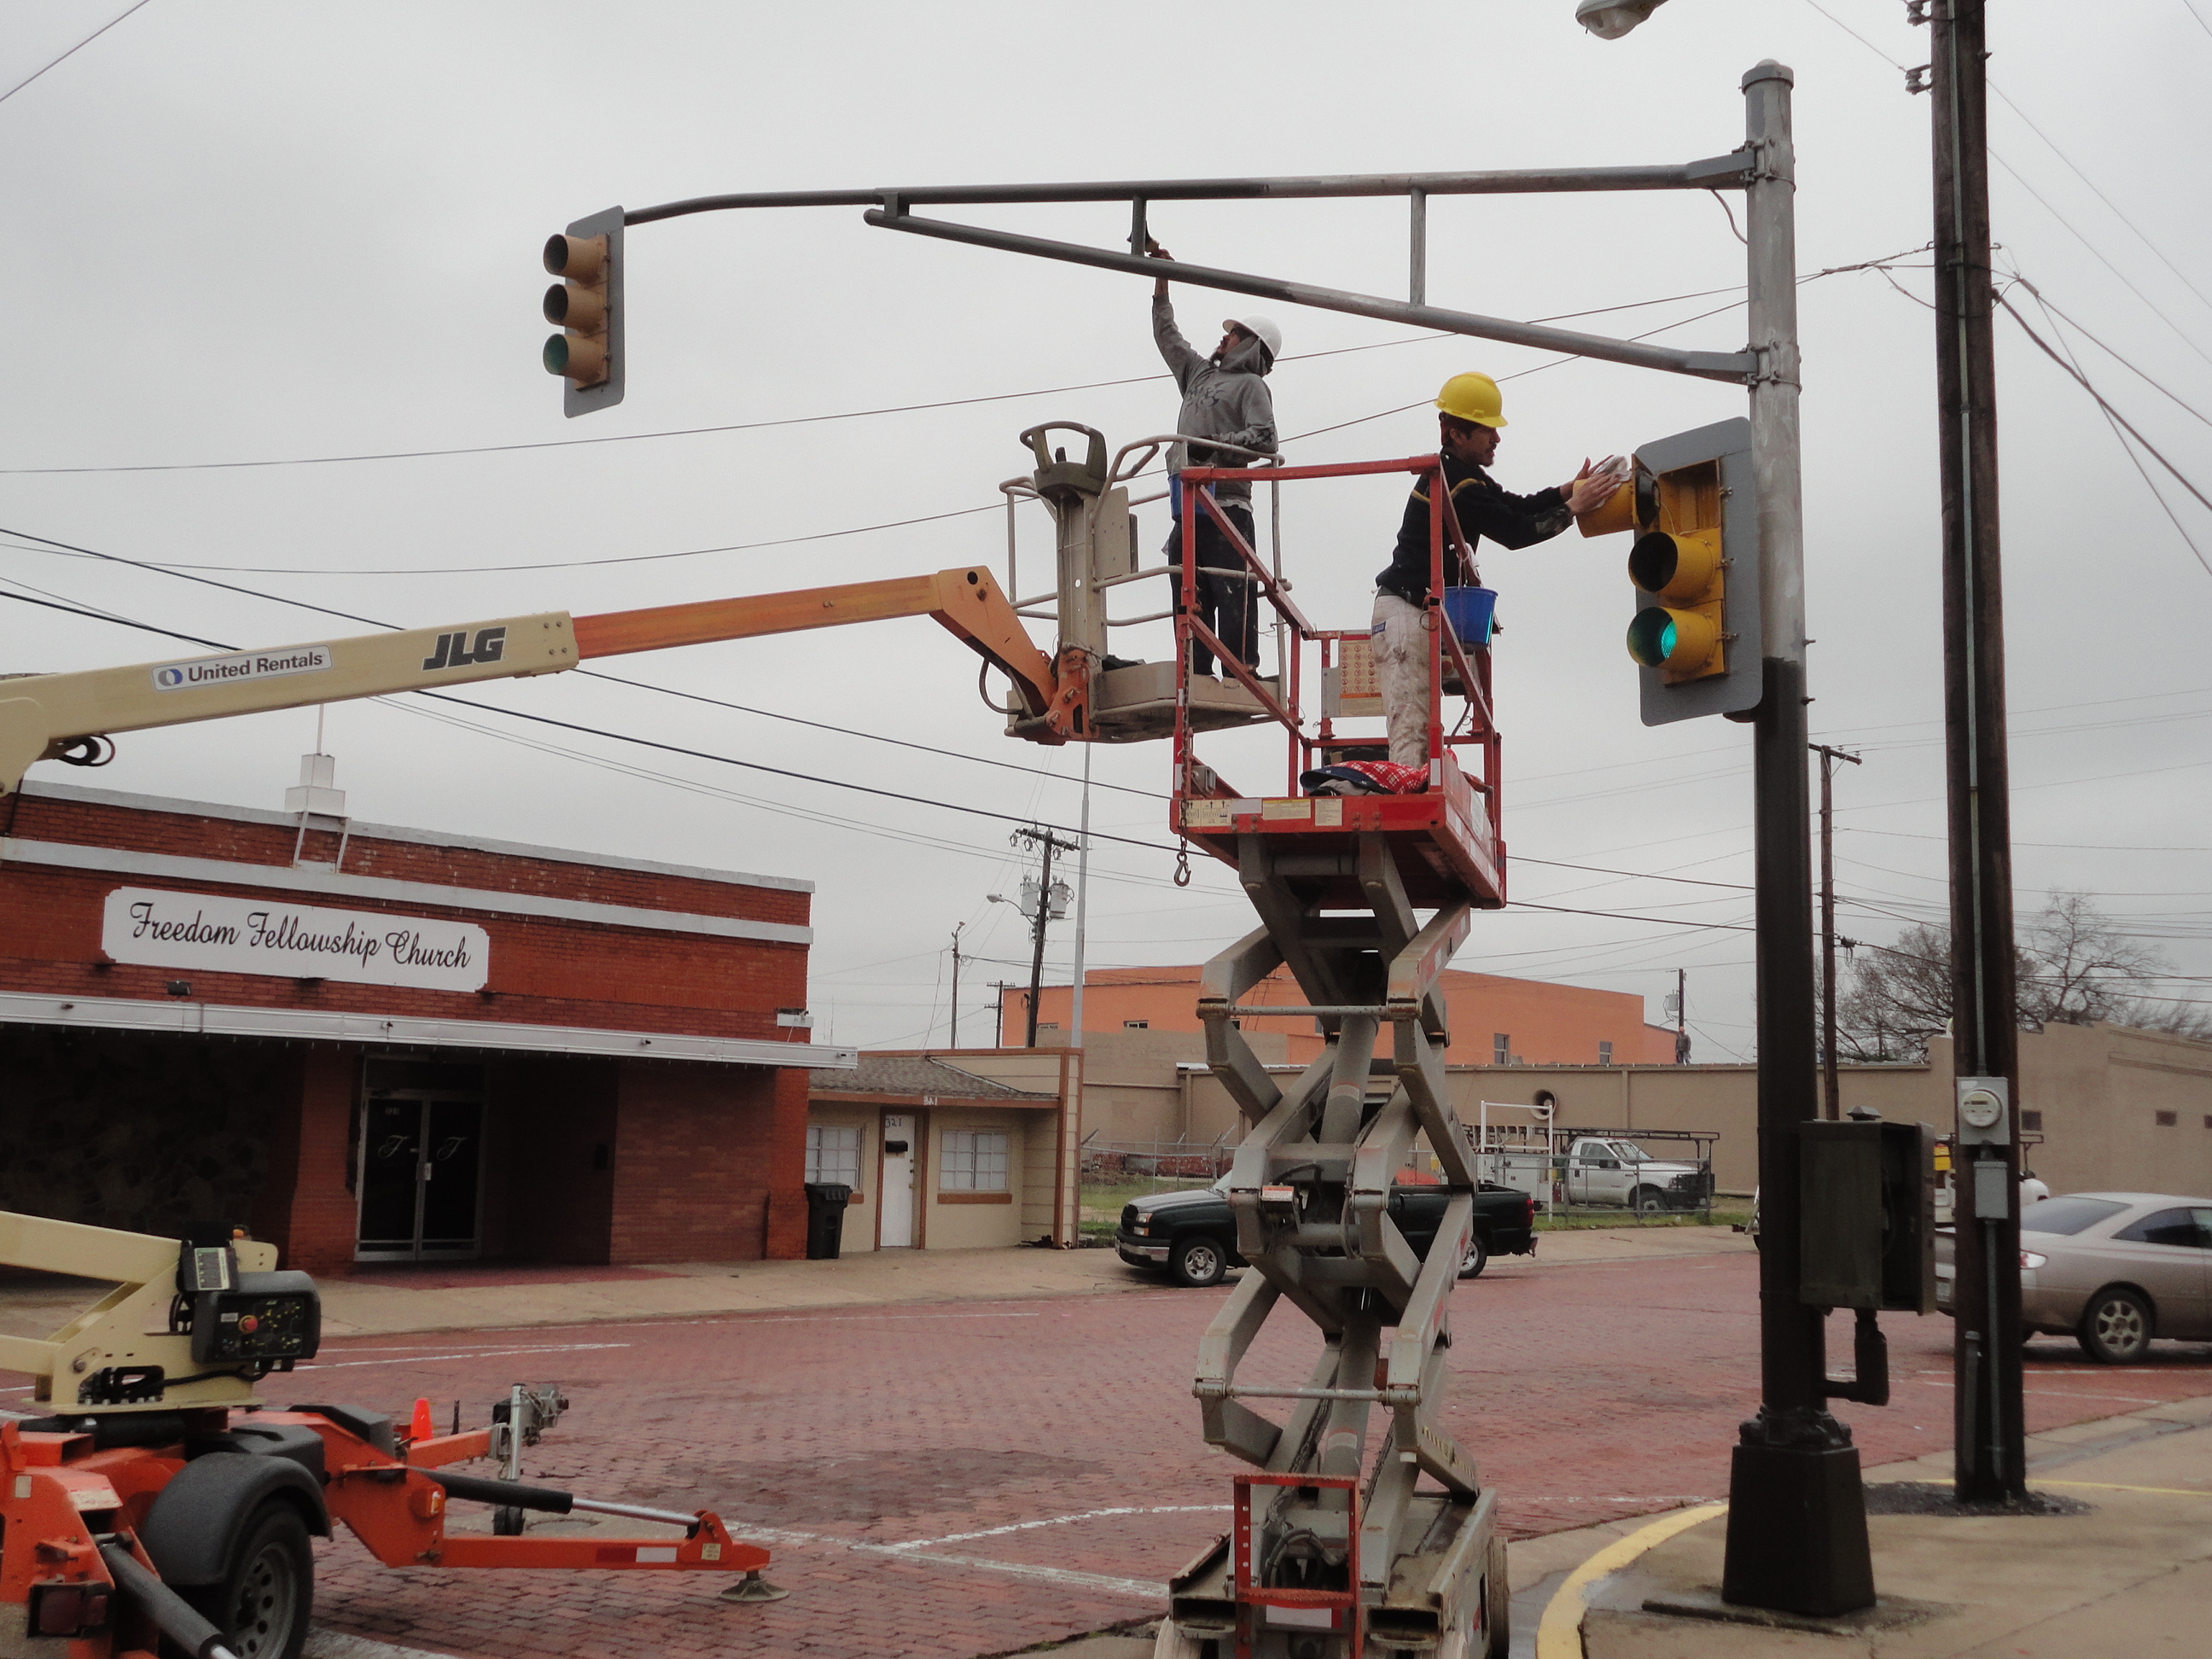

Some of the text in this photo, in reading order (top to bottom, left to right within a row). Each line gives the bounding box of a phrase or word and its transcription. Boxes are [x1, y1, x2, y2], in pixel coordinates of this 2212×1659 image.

[189, 651, 323, 682] United Rentals
[422, 626, 507, 671] JLG
[130, 902, 471, 969] Freedom Fellowship Church
[885, 1118, 902, 1128] 321
